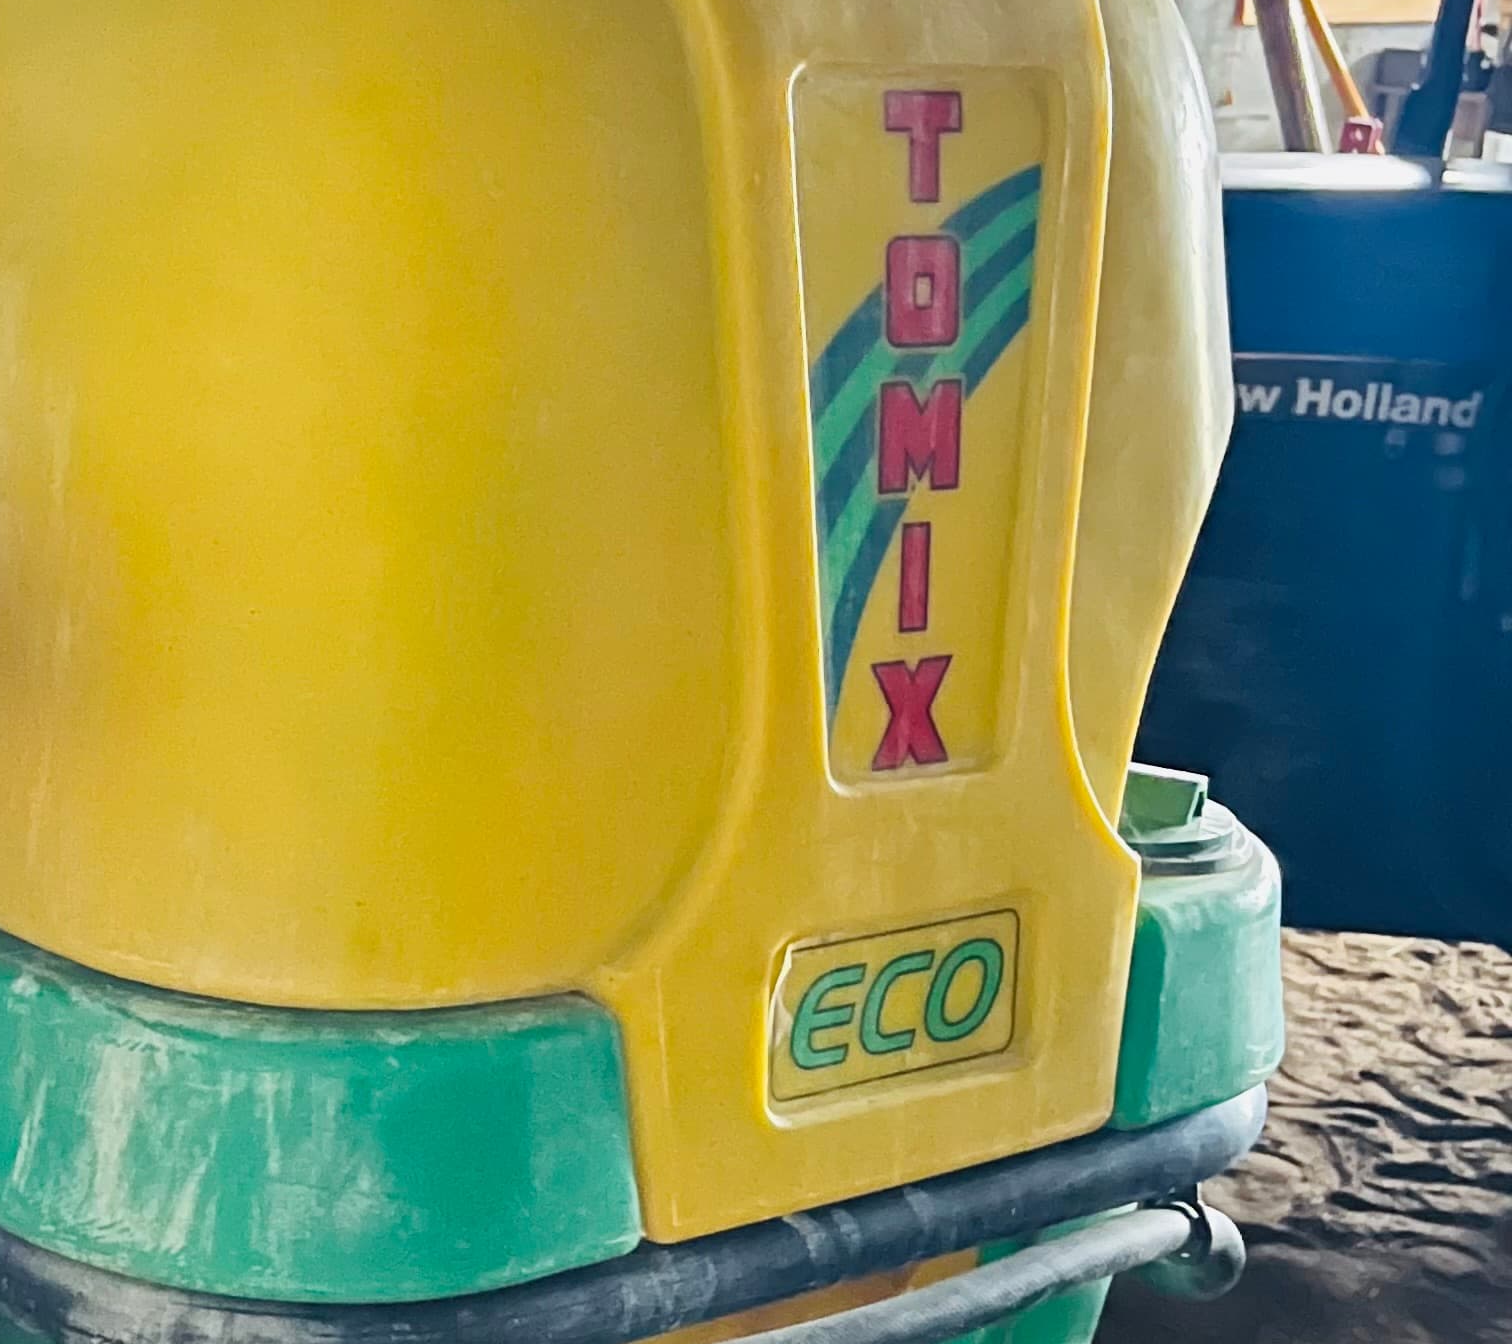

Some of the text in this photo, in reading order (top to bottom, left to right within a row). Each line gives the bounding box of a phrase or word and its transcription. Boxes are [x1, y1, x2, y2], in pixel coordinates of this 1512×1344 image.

[871, 89, 963, 773] TOMIX
[1233, 377, 1484, 428] w Holland
[790, 937, 1004, 1071] ECO
